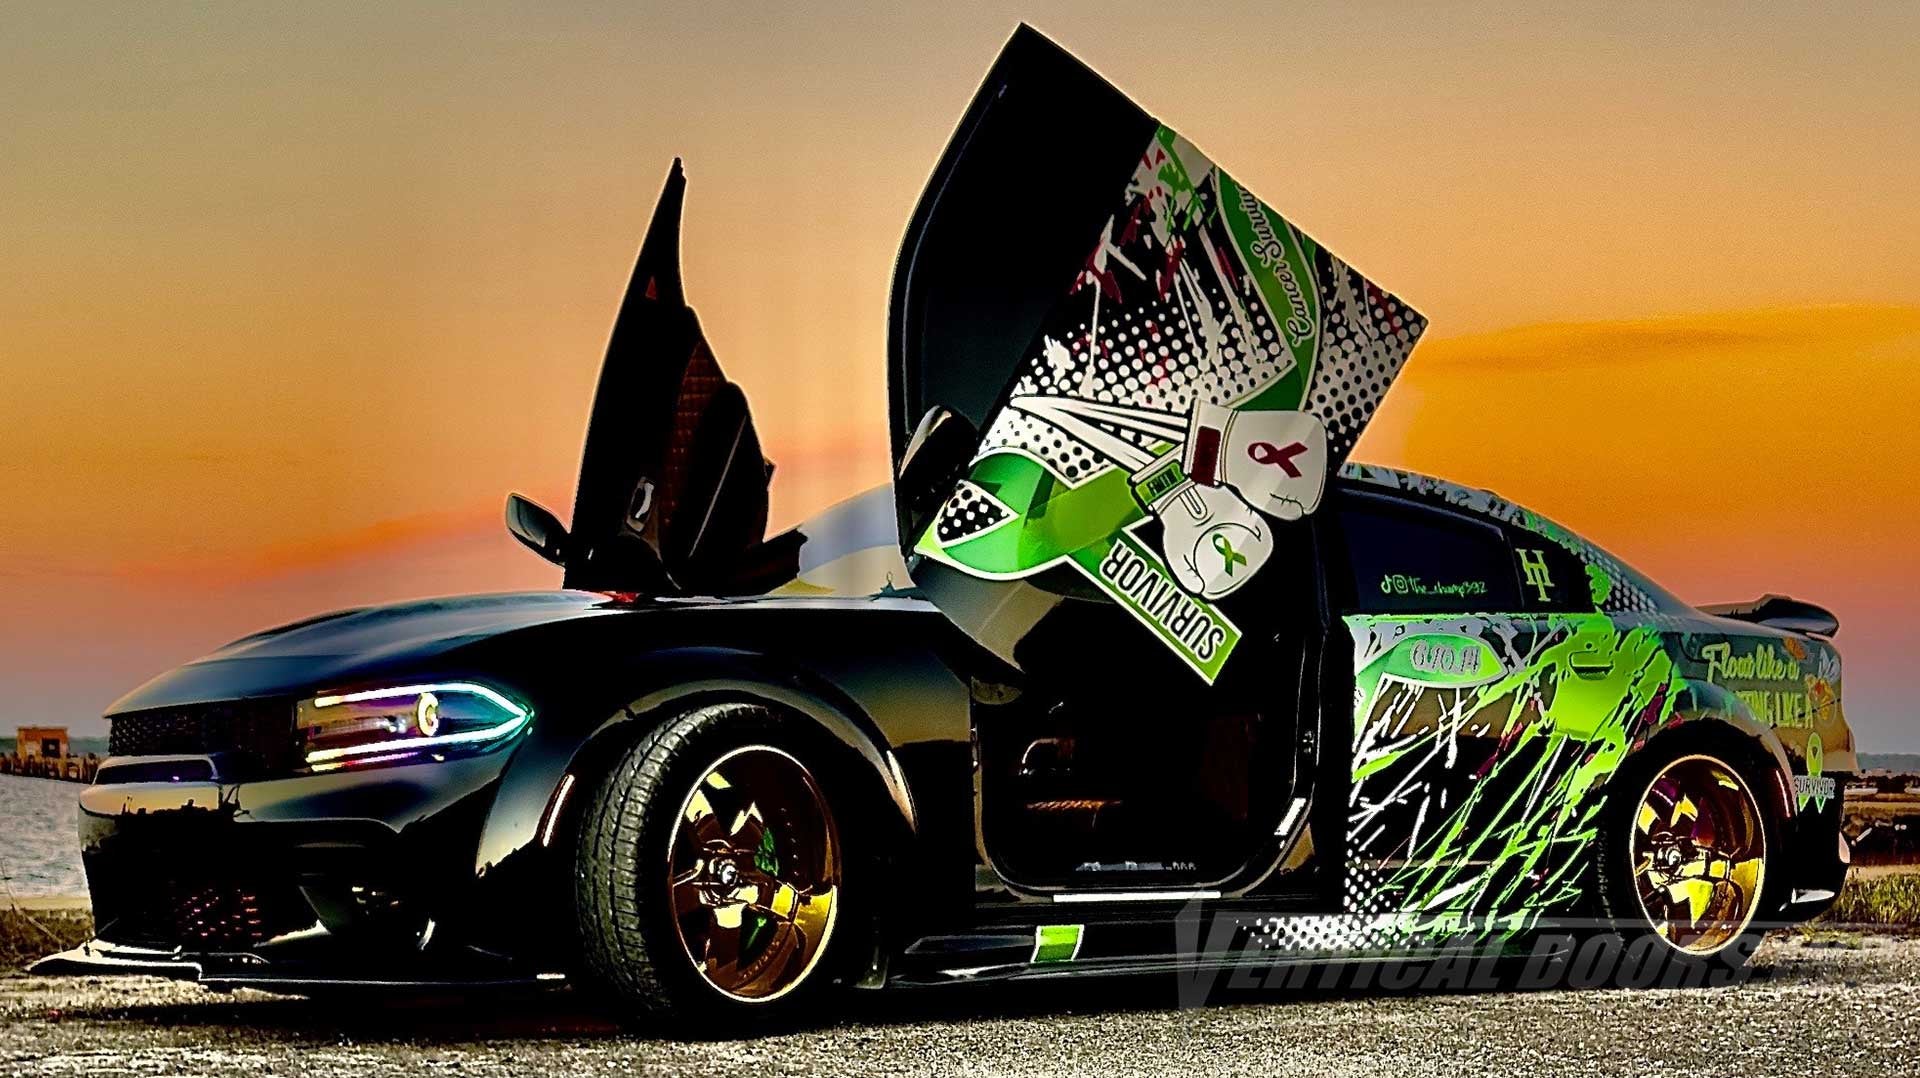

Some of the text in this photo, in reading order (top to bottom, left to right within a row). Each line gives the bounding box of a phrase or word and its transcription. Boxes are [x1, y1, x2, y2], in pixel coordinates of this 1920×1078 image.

[1273, 261, 1315, 347] Cancer
[1101, 539, 1225, 662] SURVIVOR
[1702, 642, 1800, 684] Float like a
[1775, 691, 1802, 727] LIKE
[1794, 776, 1836, 799] SURVIVOR
